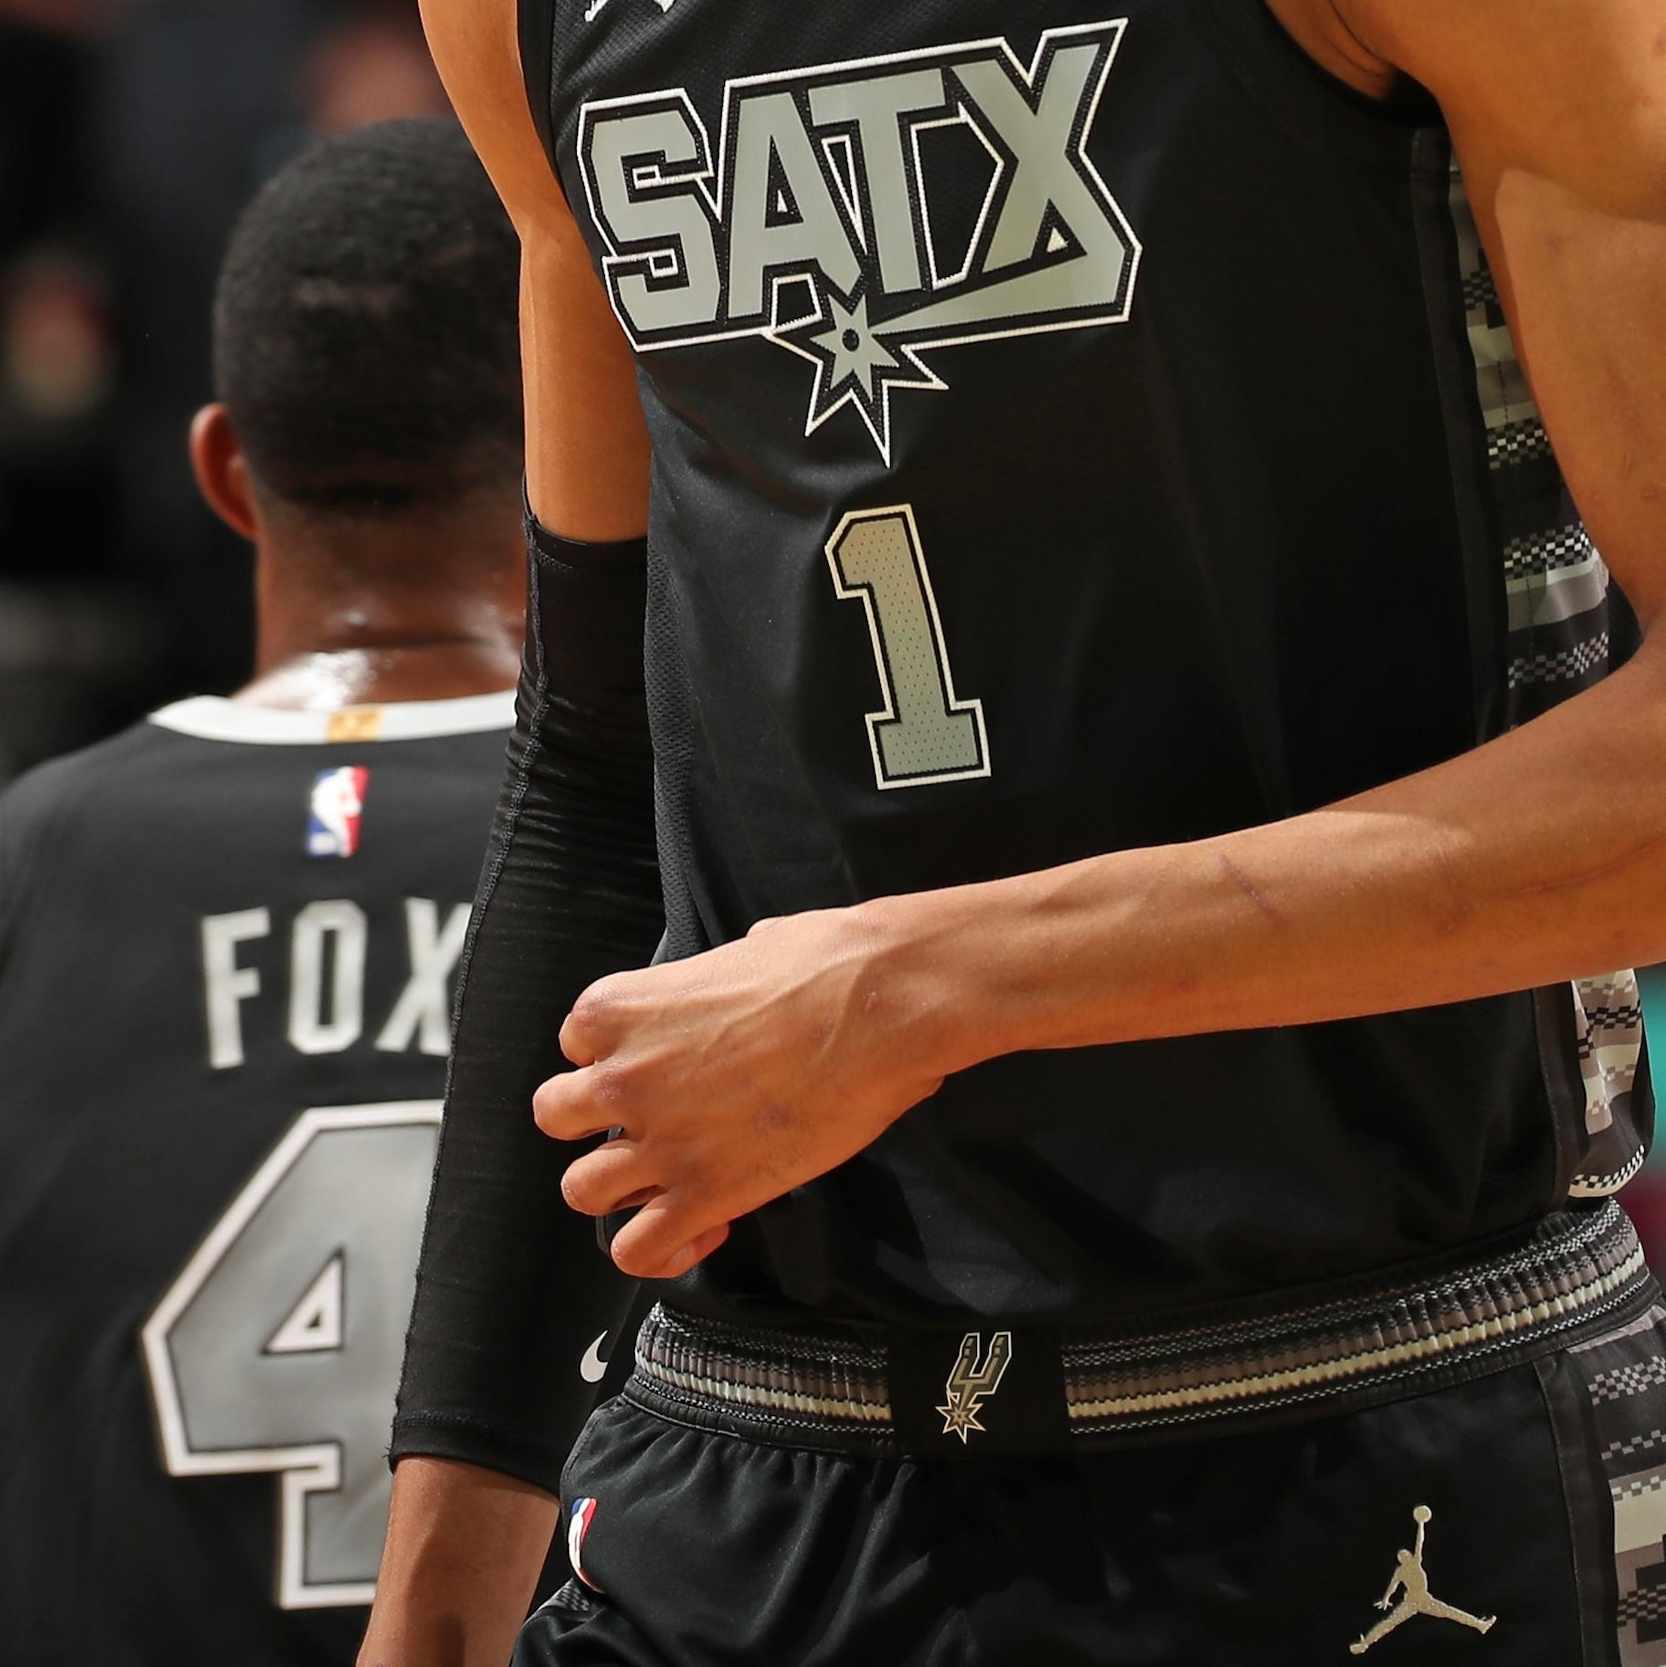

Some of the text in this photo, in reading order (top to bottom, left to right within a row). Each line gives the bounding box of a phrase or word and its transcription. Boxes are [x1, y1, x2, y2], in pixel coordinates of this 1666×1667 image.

[577, 18, 1143, 352] SATX
[824, 503, 992, 791] 1
[200, 896, 473, 1070] FOX
[142, 1100, 444, 1611] 4
